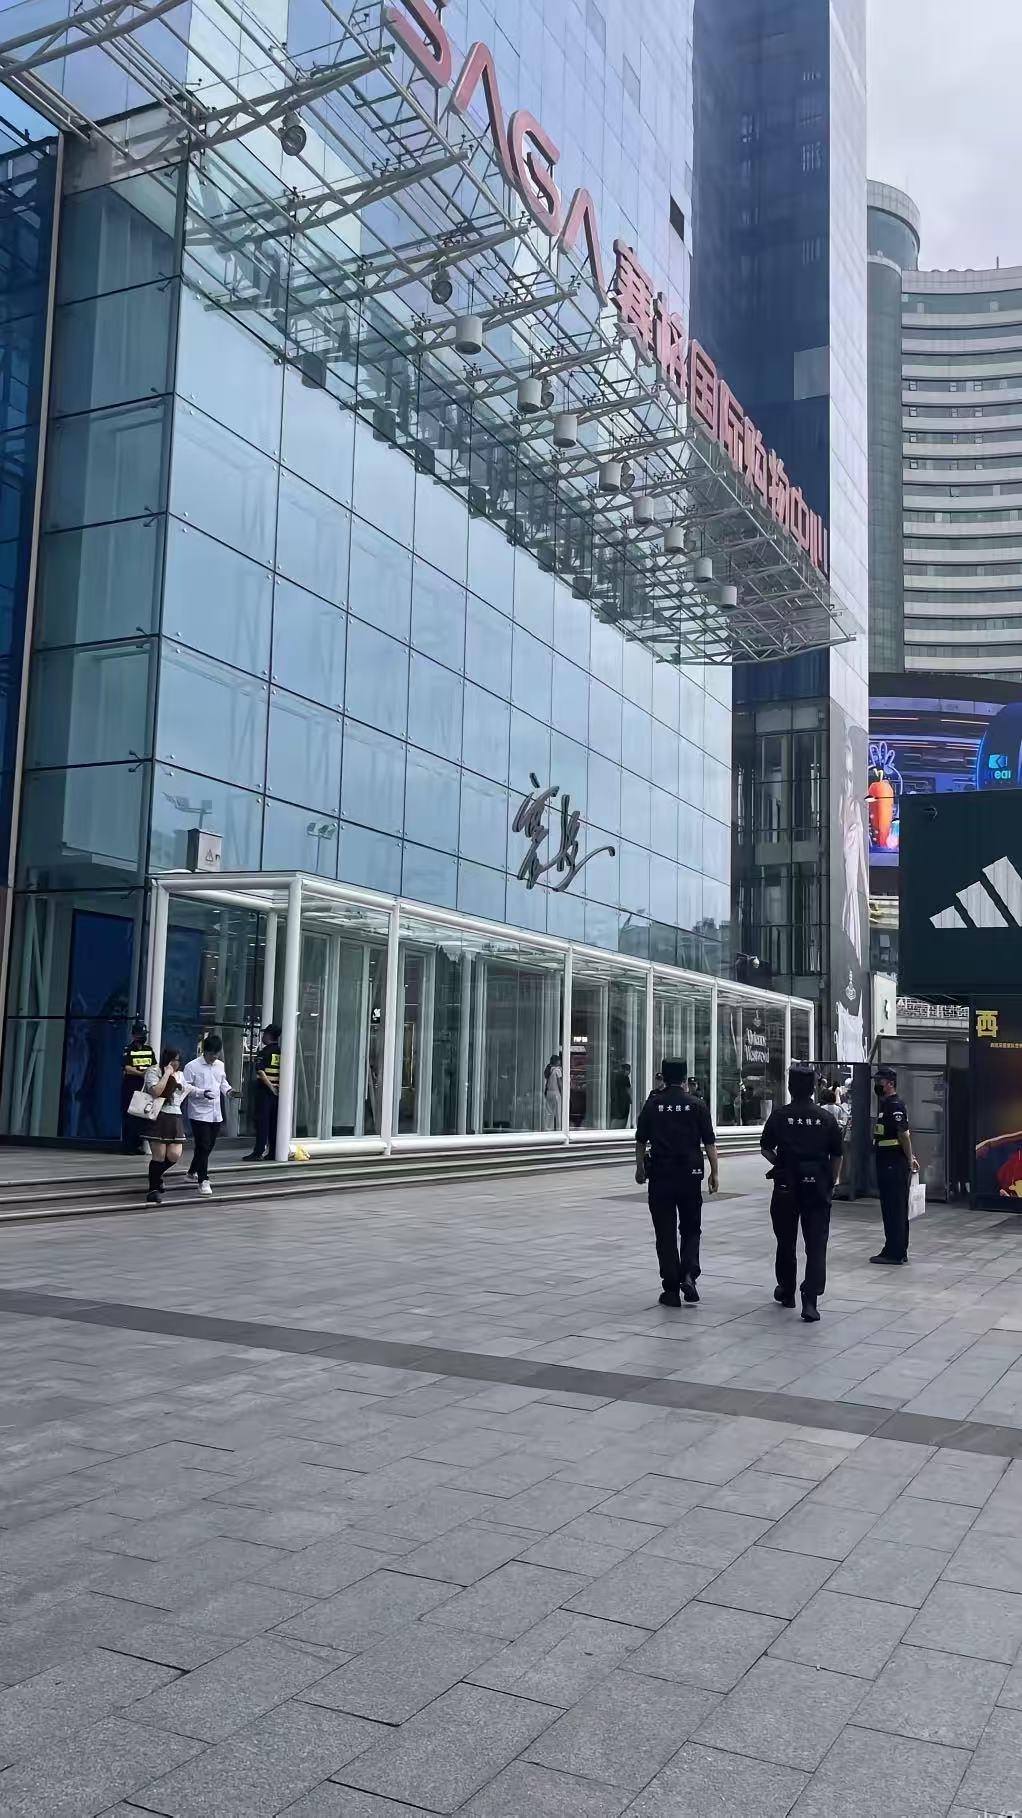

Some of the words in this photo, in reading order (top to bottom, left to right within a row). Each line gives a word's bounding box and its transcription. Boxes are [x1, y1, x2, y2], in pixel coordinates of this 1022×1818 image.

[609, 238, 829, 578] 赛格国际购物中心
[975, 1010, 999, 1037] 西
